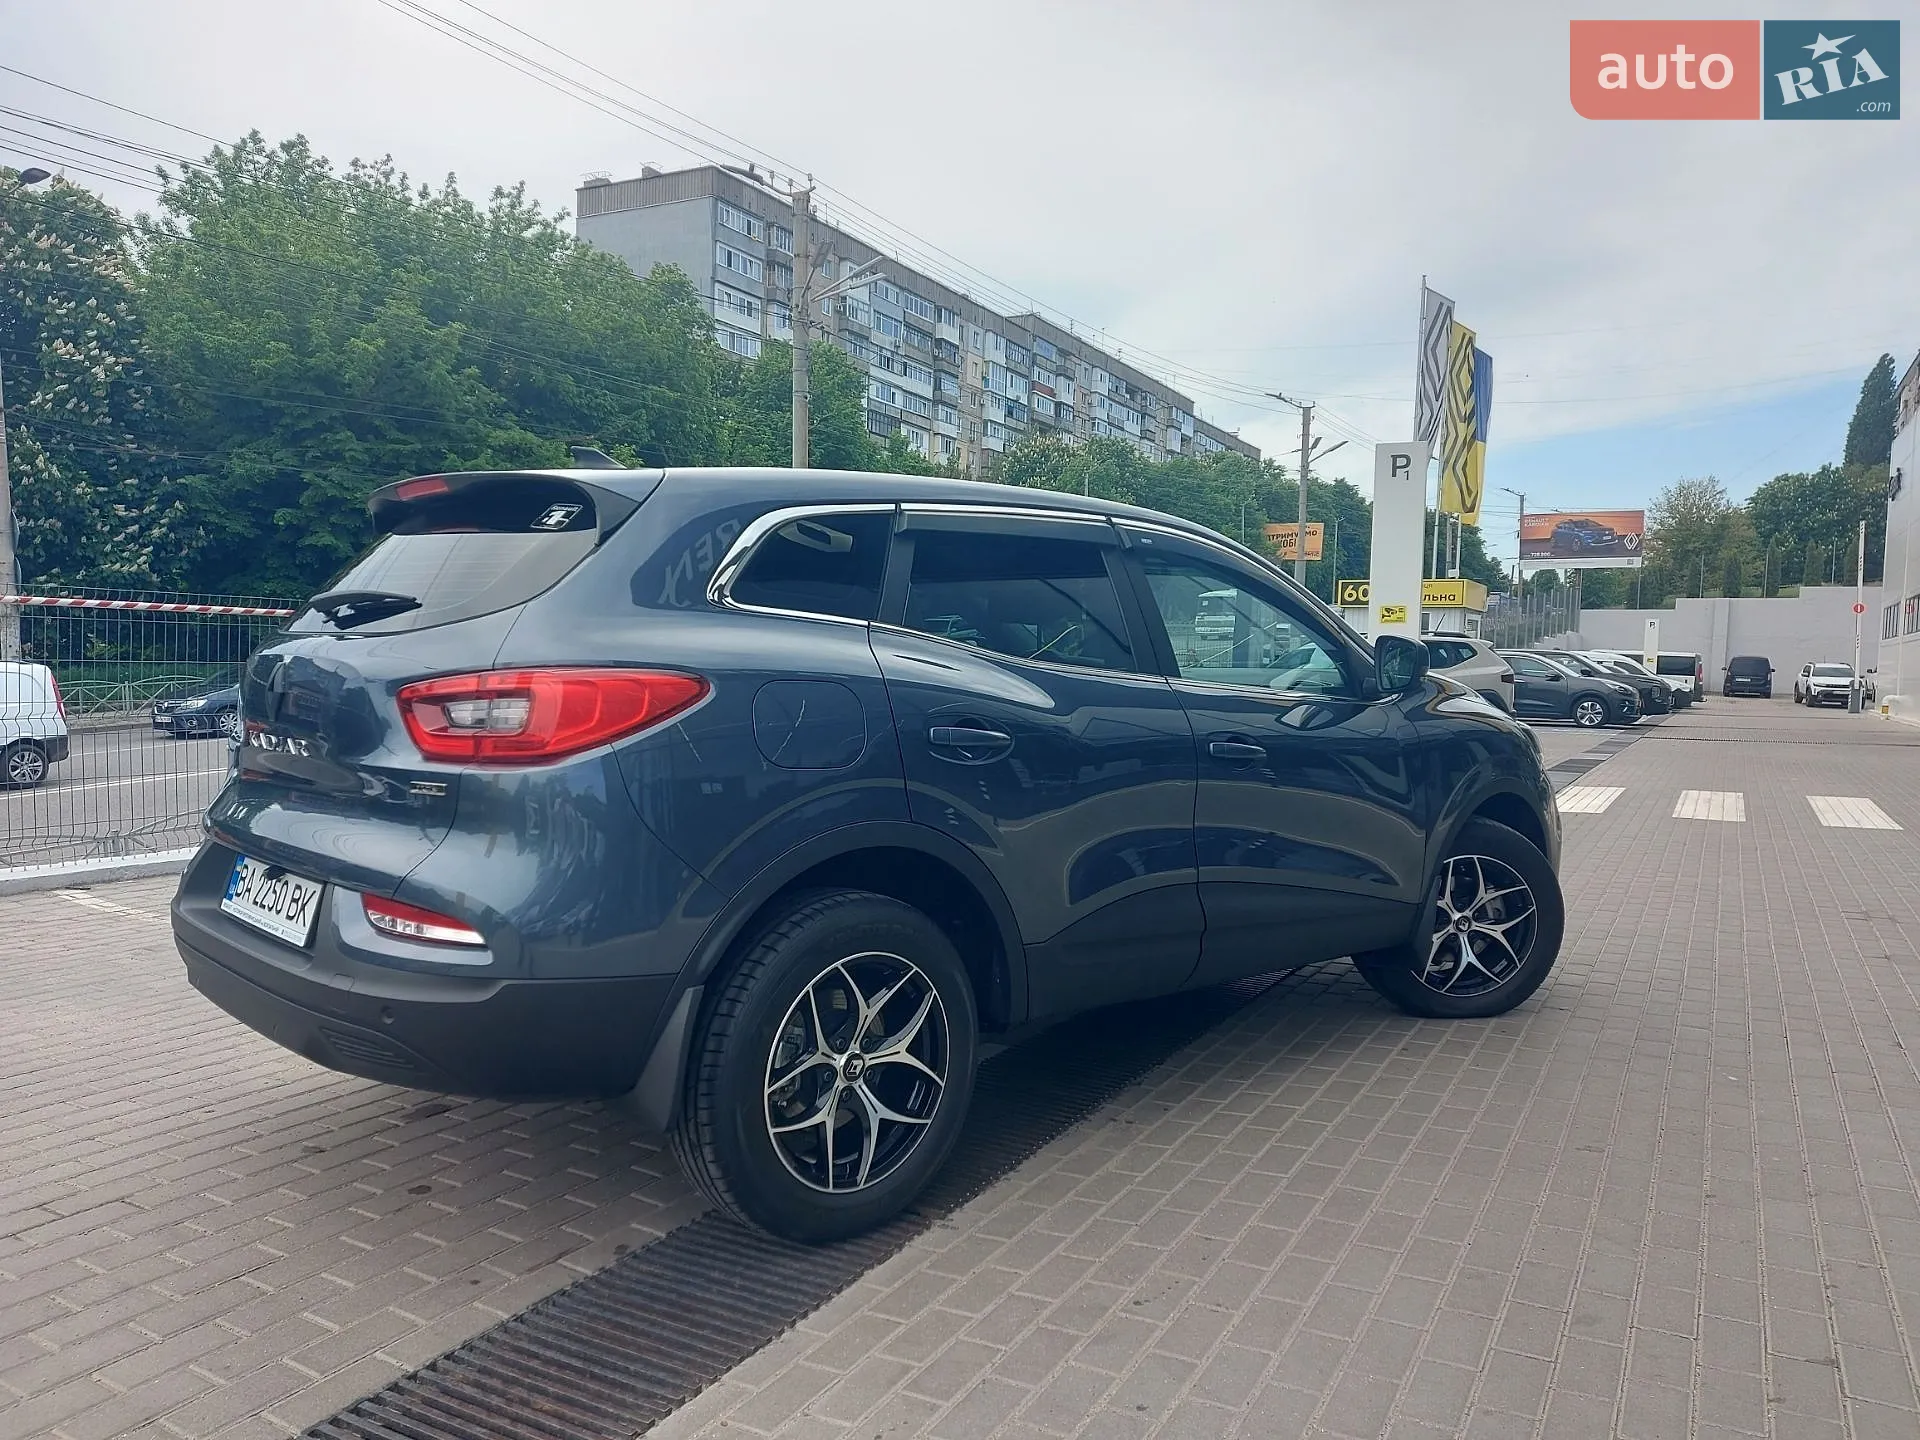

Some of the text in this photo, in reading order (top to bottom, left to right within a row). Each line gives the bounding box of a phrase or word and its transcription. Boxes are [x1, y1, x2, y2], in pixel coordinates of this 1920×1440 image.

[1423, 593, 1457, 602] льна
[234, 863, 257, 903] BA
[252, 873, 289, 915] 2250
[284, 883, 317, 927] BK
